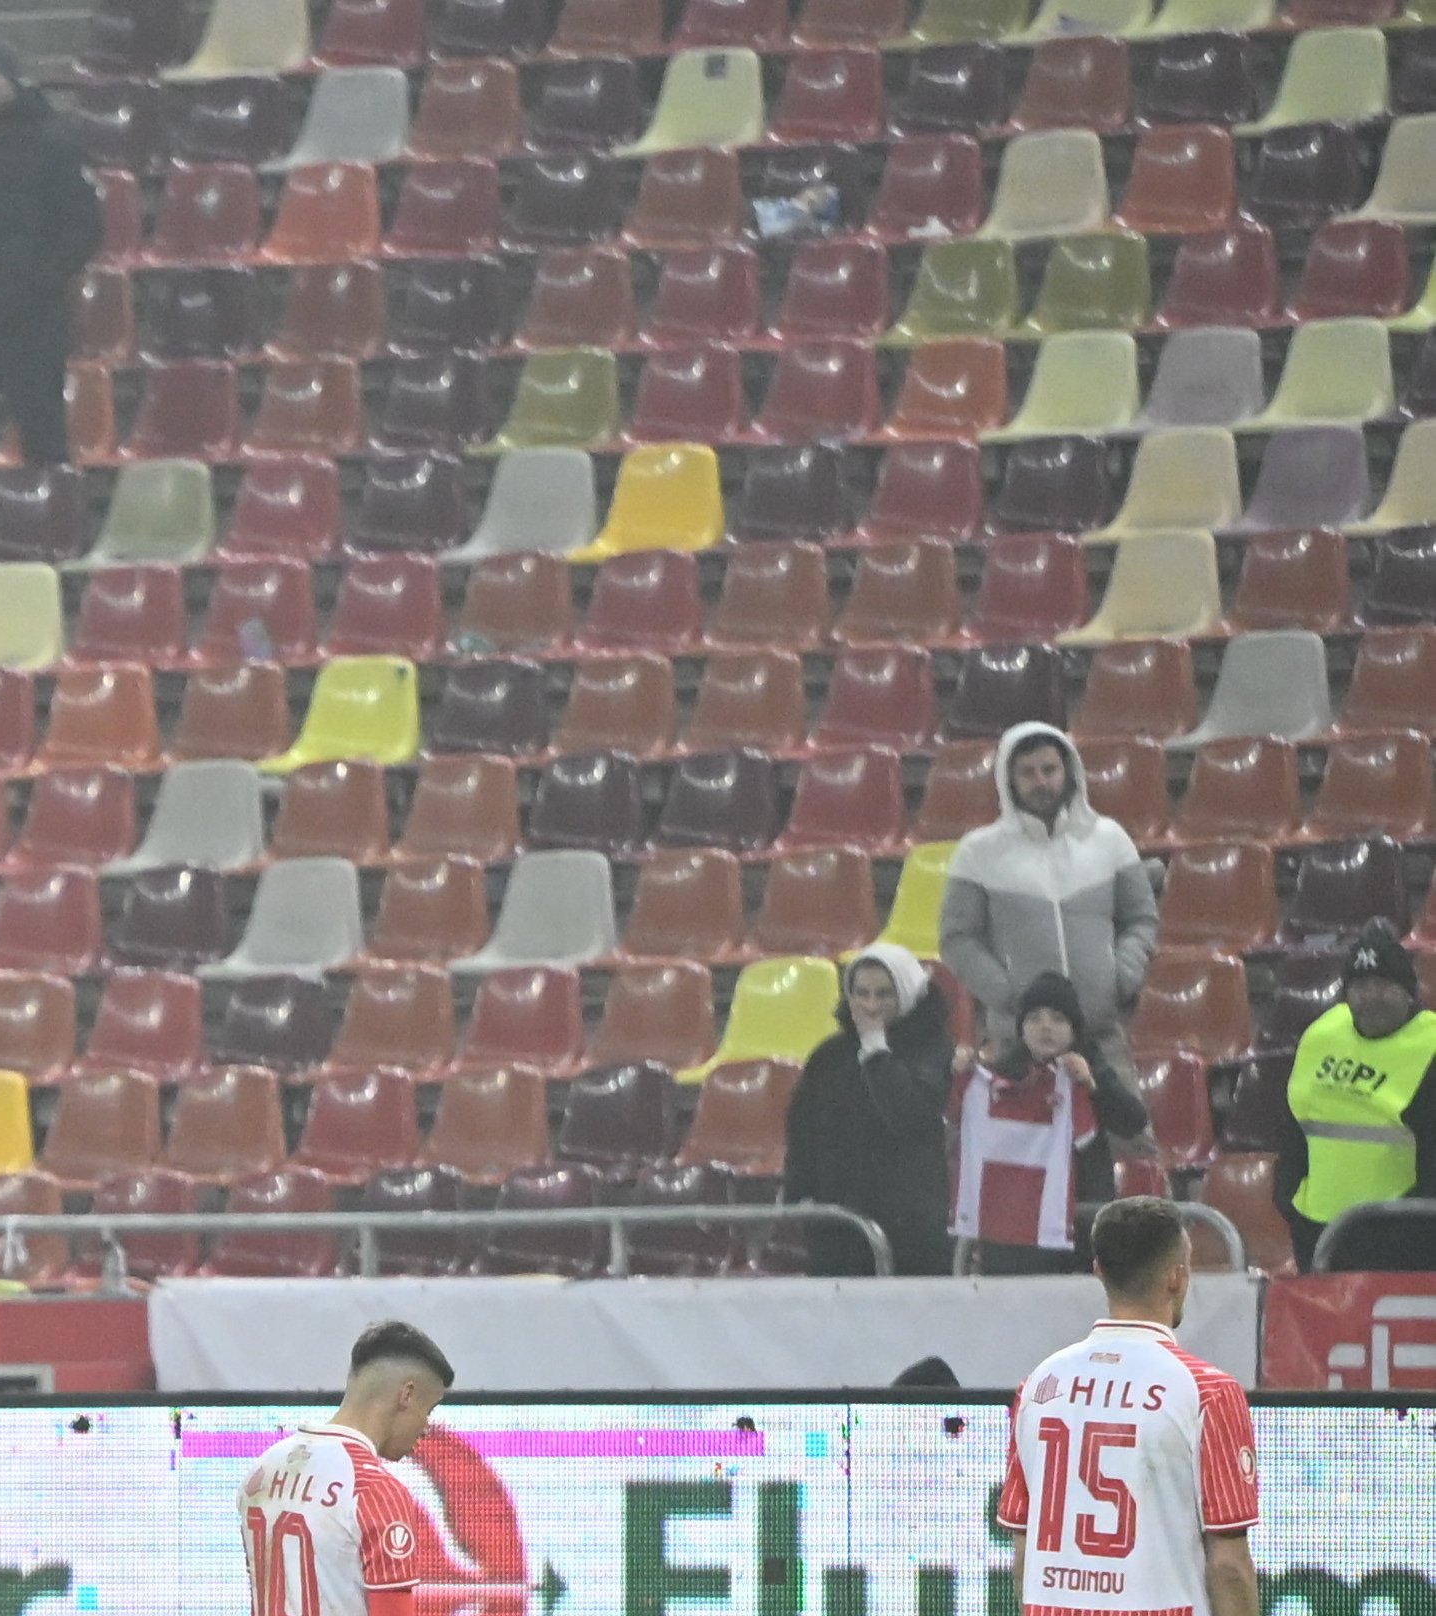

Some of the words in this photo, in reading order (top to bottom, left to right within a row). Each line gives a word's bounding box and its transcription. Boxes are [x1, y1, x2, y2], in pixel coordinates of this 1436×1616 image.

[1068, 1375, 1167, 1412] HILS
[268, 1470, 344, 1508] HILS
[1036, 1416, 1138, 1559] 15
